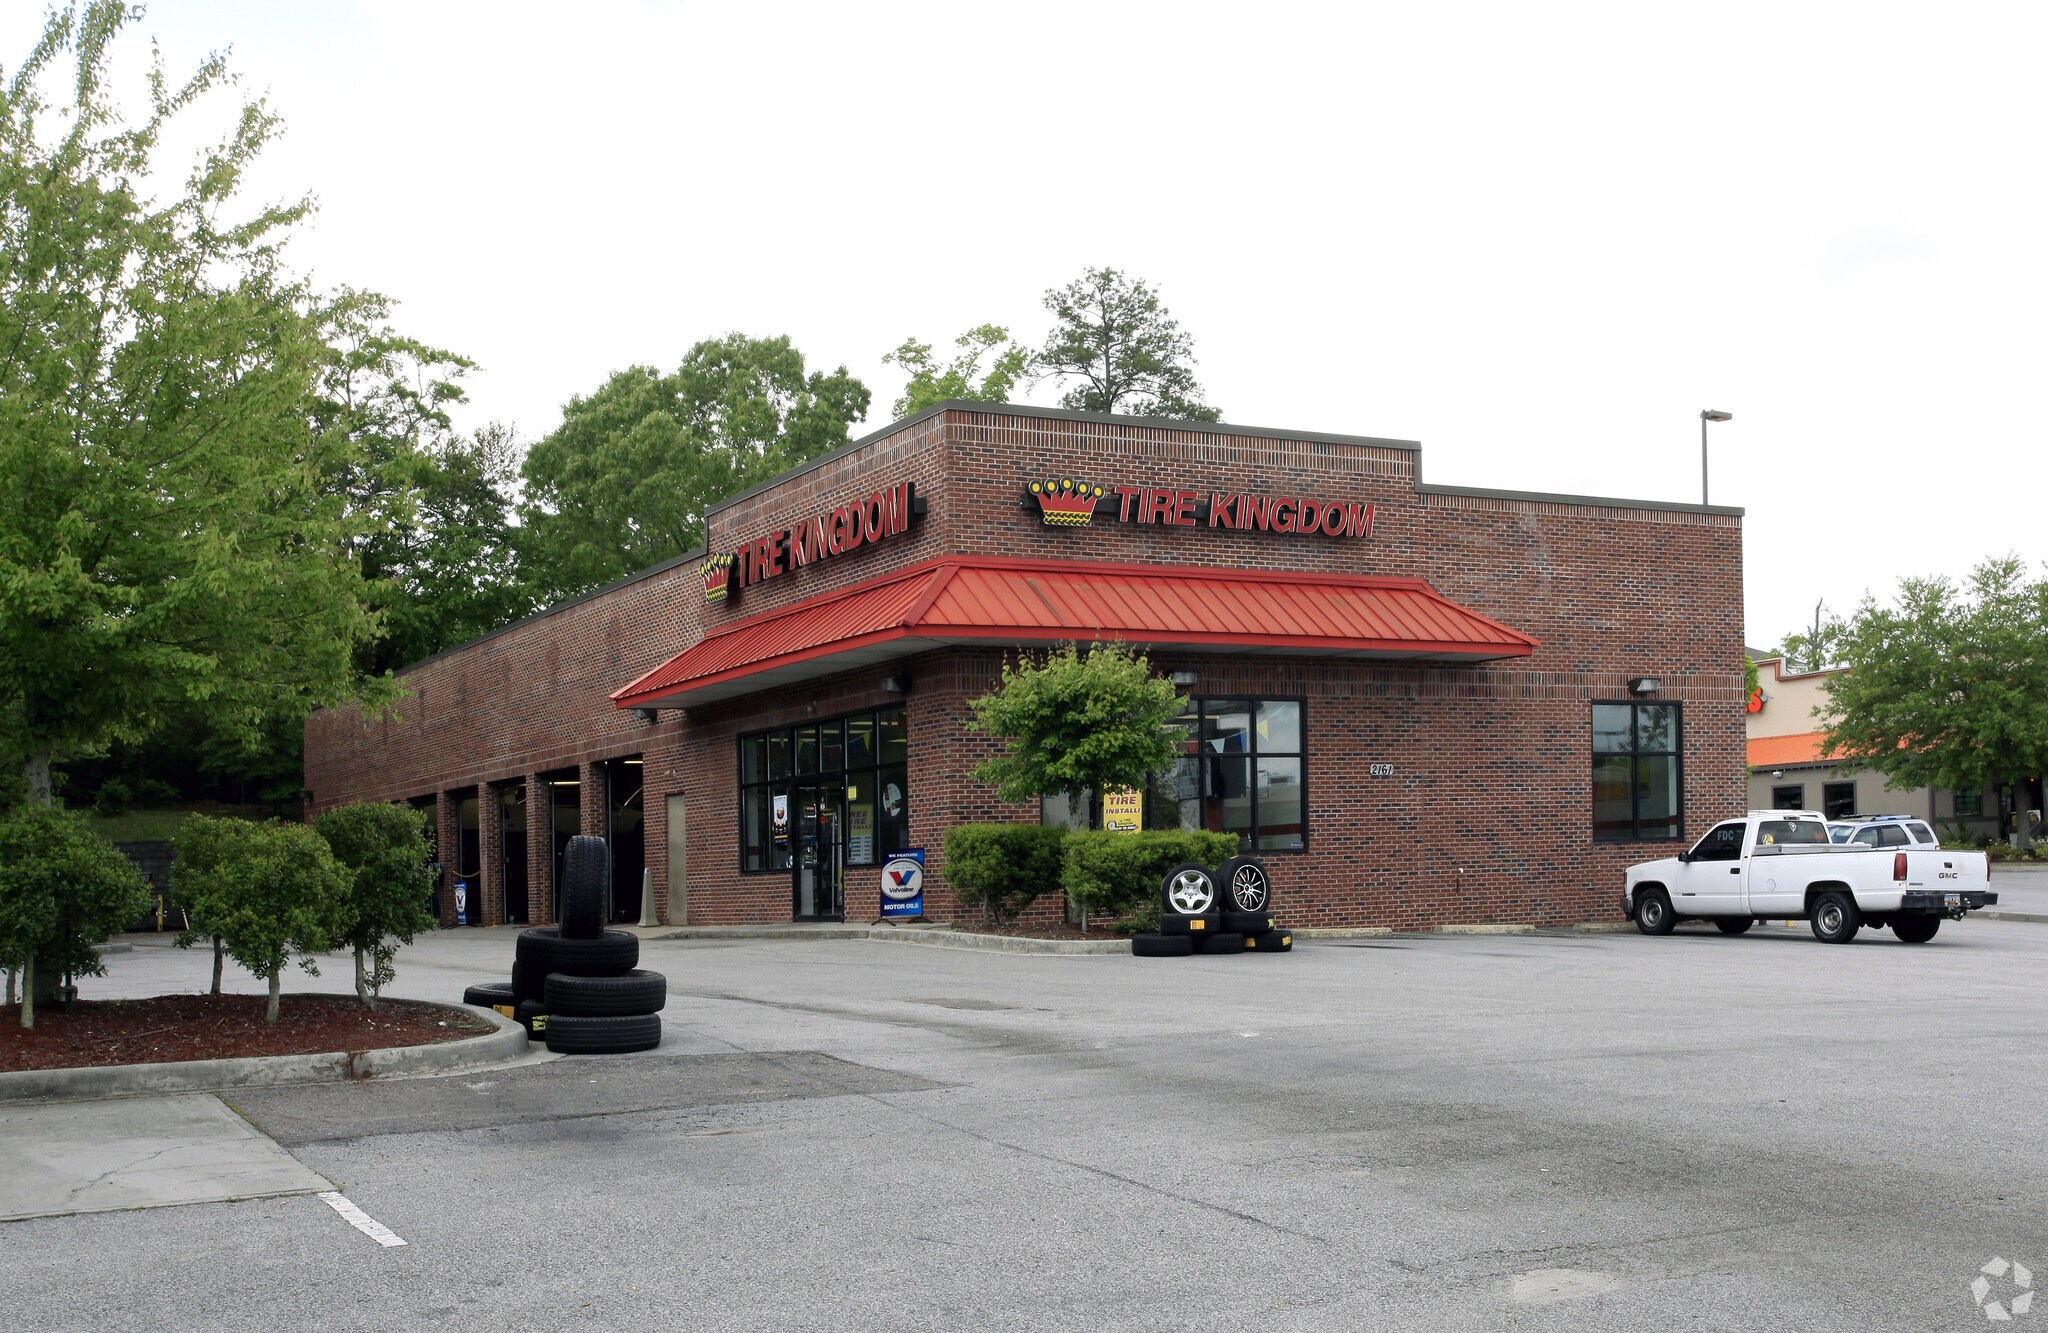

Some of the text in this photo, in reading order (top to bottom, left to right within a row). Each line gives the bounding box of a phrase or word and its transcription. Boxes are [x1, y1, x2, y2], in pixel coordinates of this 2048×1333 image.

[1113, 487, 1376, 537] TIRE KINGDOM
[737, 481, 909, 588] TIRE KINGDOM
[1109, 796, 1137, 805] TIRE
[1717, 830, 1734, 841] FDC
